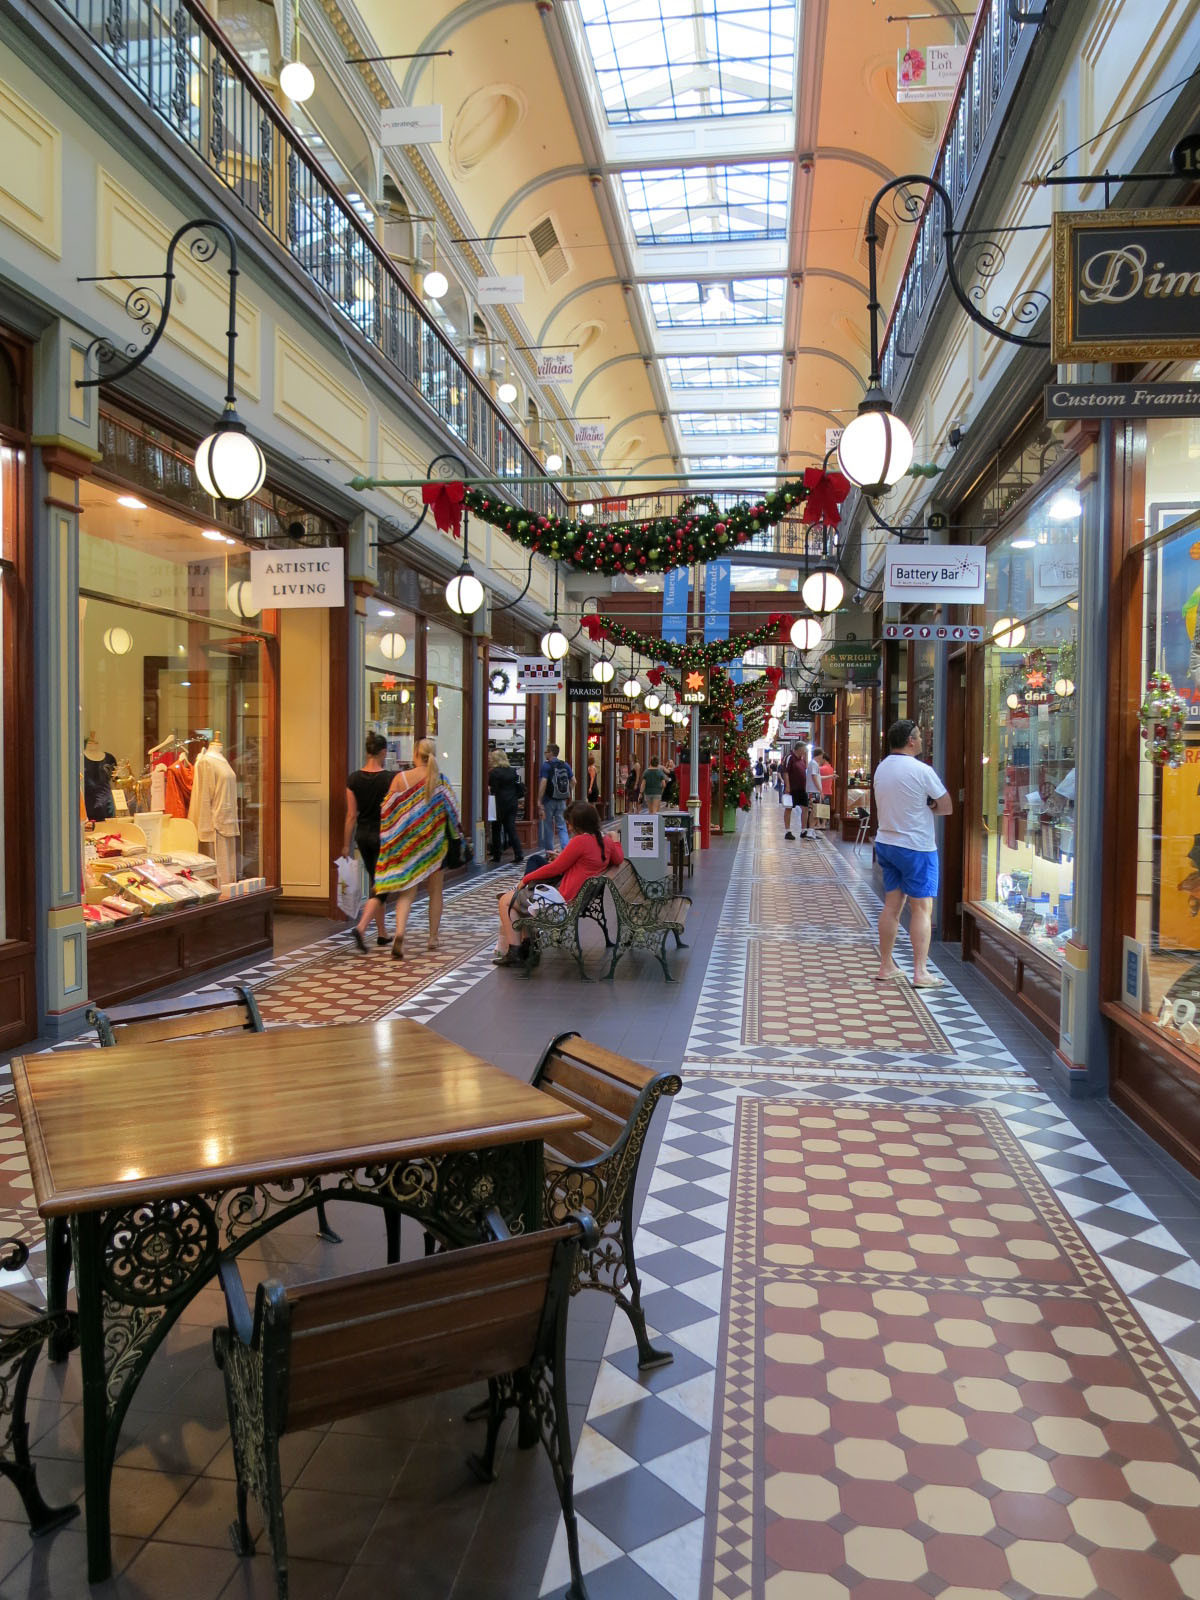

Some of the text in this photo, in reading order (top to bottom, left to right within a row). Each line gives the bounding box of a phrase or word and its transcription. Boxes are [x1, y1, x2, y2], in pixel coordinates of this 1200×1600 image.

[929, 49, 949, 60] The
[931, 60, 952, 70] Loft
[537, 362, 573, 376] villains
[1052, 391, 1125, 407] Custom
[931, 516, 942, 527] 21
[265, 562, 330, 574] ARTISTIC
[896, 567, 959, 582] Battery Bar
[272, 583, 326, 595] LIVING
[839, 654, 878, 662] WRIGHT
[569, 688, 602, 696] PARAISO
[684, 691, 705, 702] nab
